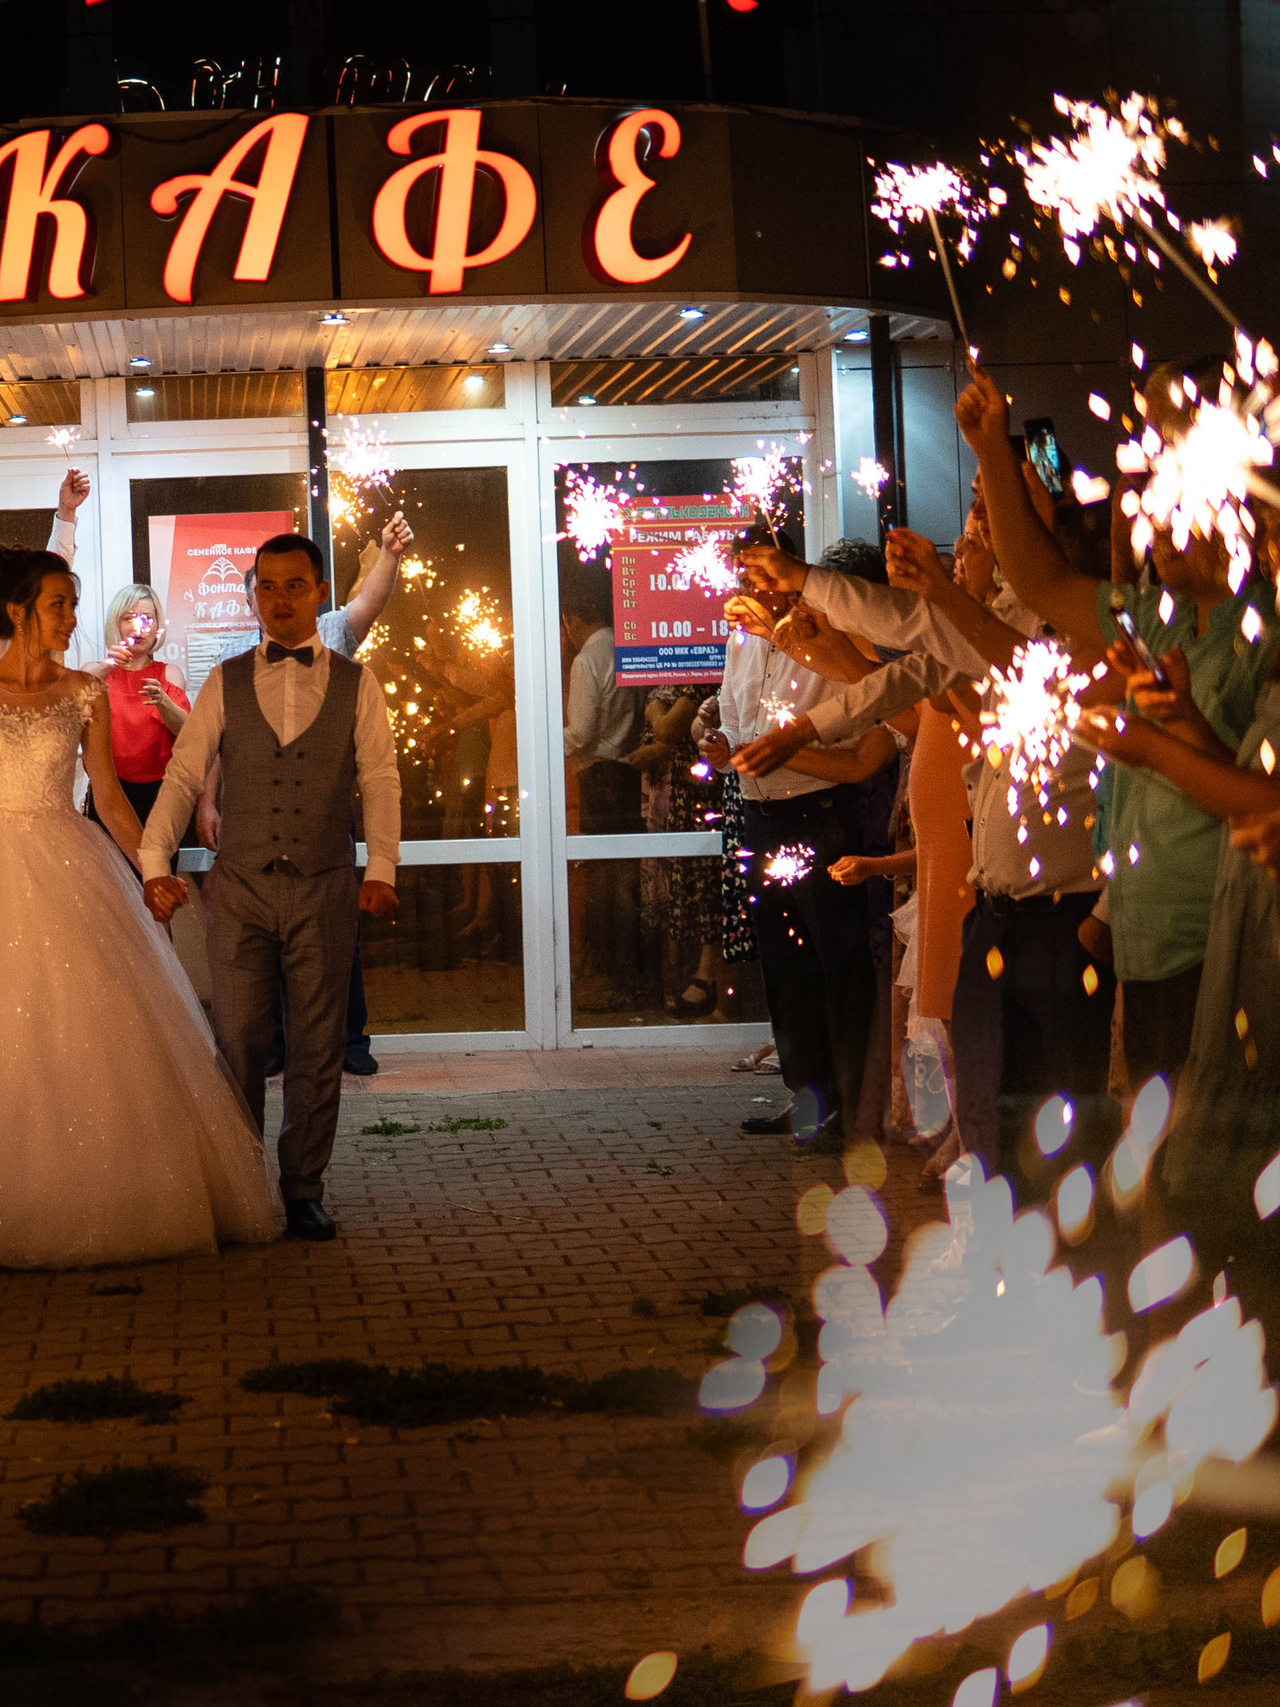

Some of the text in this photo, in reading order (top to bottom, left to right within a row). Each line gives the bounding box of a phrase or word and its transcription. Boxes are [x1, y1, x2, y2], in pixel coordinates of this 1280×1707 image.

[629, 529, 681, 543] РЕЖИМ
[234, 546, 257, 555] КАФЕ
[621, 556, 636, 565] Пн
[622, 567, 636, 575] Вт
[622, 578, 636, 588] Ср
[197, 581, 247, 597] Фонта
[622, 589, 637, 597] Чт
[623, 599, 637, 608] Пт
[623, 621, 637, 630] Сб
[624, 632, 637, 641] Вс
[651, 620, 692, 638] 10.00
[658, 647, 674, 656] ООО
